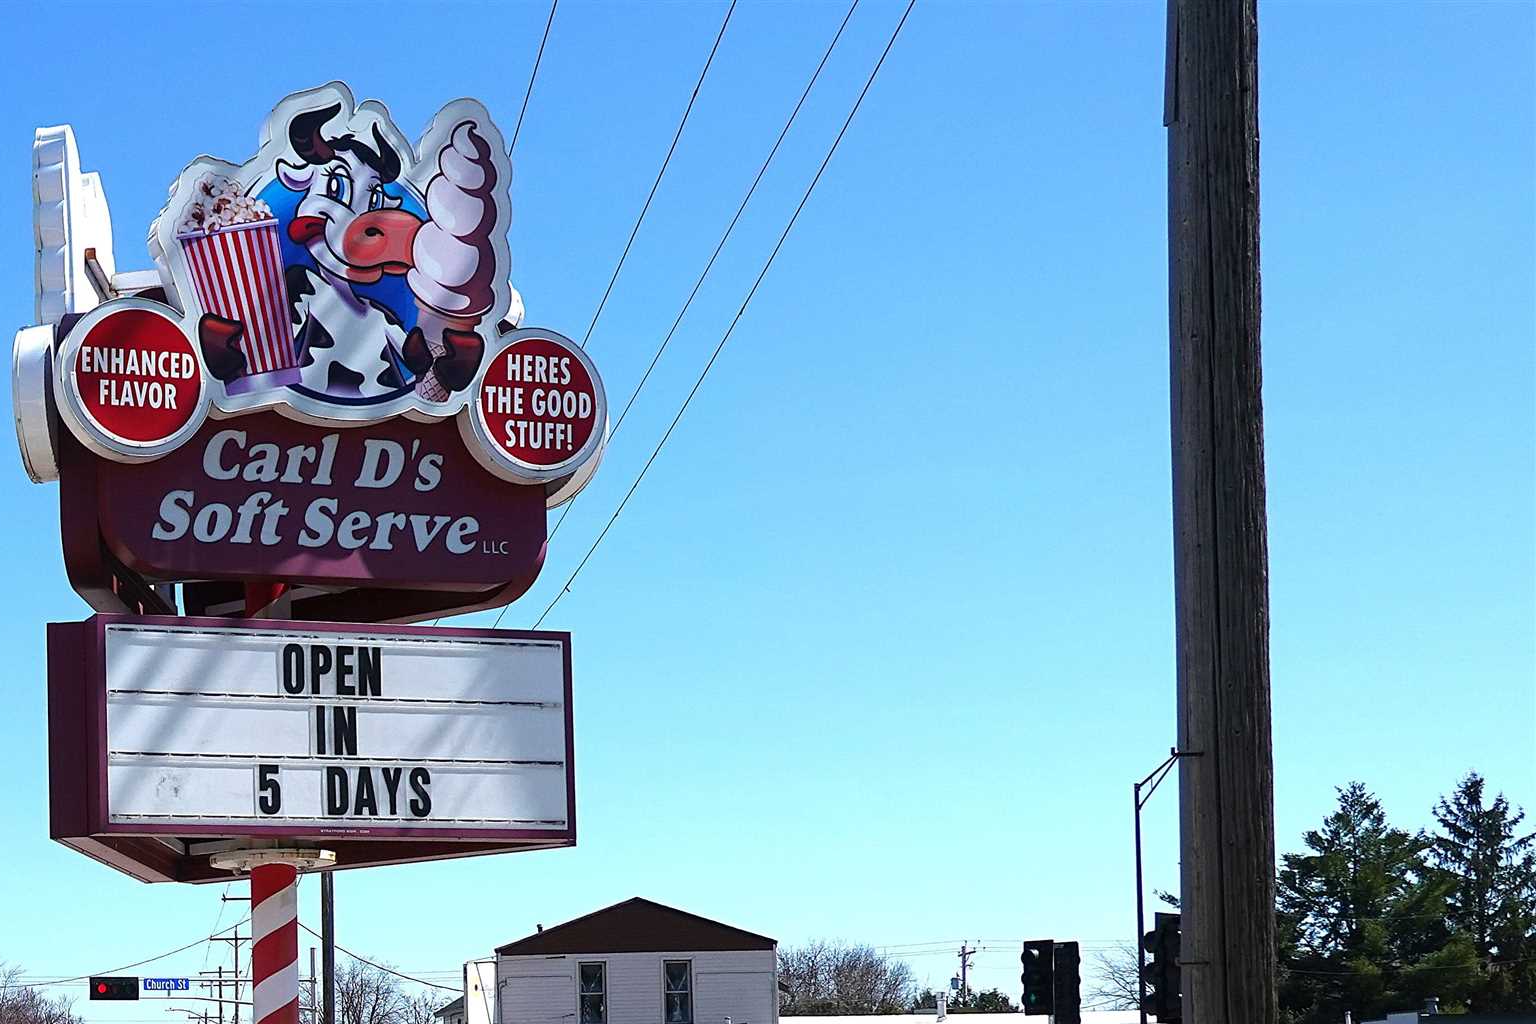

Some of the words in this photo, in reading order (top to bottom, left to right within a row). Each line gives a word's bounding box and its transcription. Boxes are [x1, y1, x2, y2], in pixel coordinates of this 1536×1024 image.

[81, 346, 195, 380] ENHANCED
[506, 354, 571, 384] HERES
[99, 378, 177, 410] FLAVOR
[485, 386, 525, 415] THE
[531, 389, 592, 419] GOOD
[505, 418, 574, 451] STUFF!
[202, 430, 338, 486] Carl
[354, 440, 444, 492] D's
[152, 490, 289, 547] Soft
[297, 497, 479, 555] Serve
[483, 543, 509, 555] LLC
[283, 643, 382, 697] OPEN
[316, 705, 357, 755] IN
[259, 765, 281, 815] 5
[326, 767, 432, 818] DAYS
[146, 979, 175, 990] Church
[177, 979, 187, 990] St
